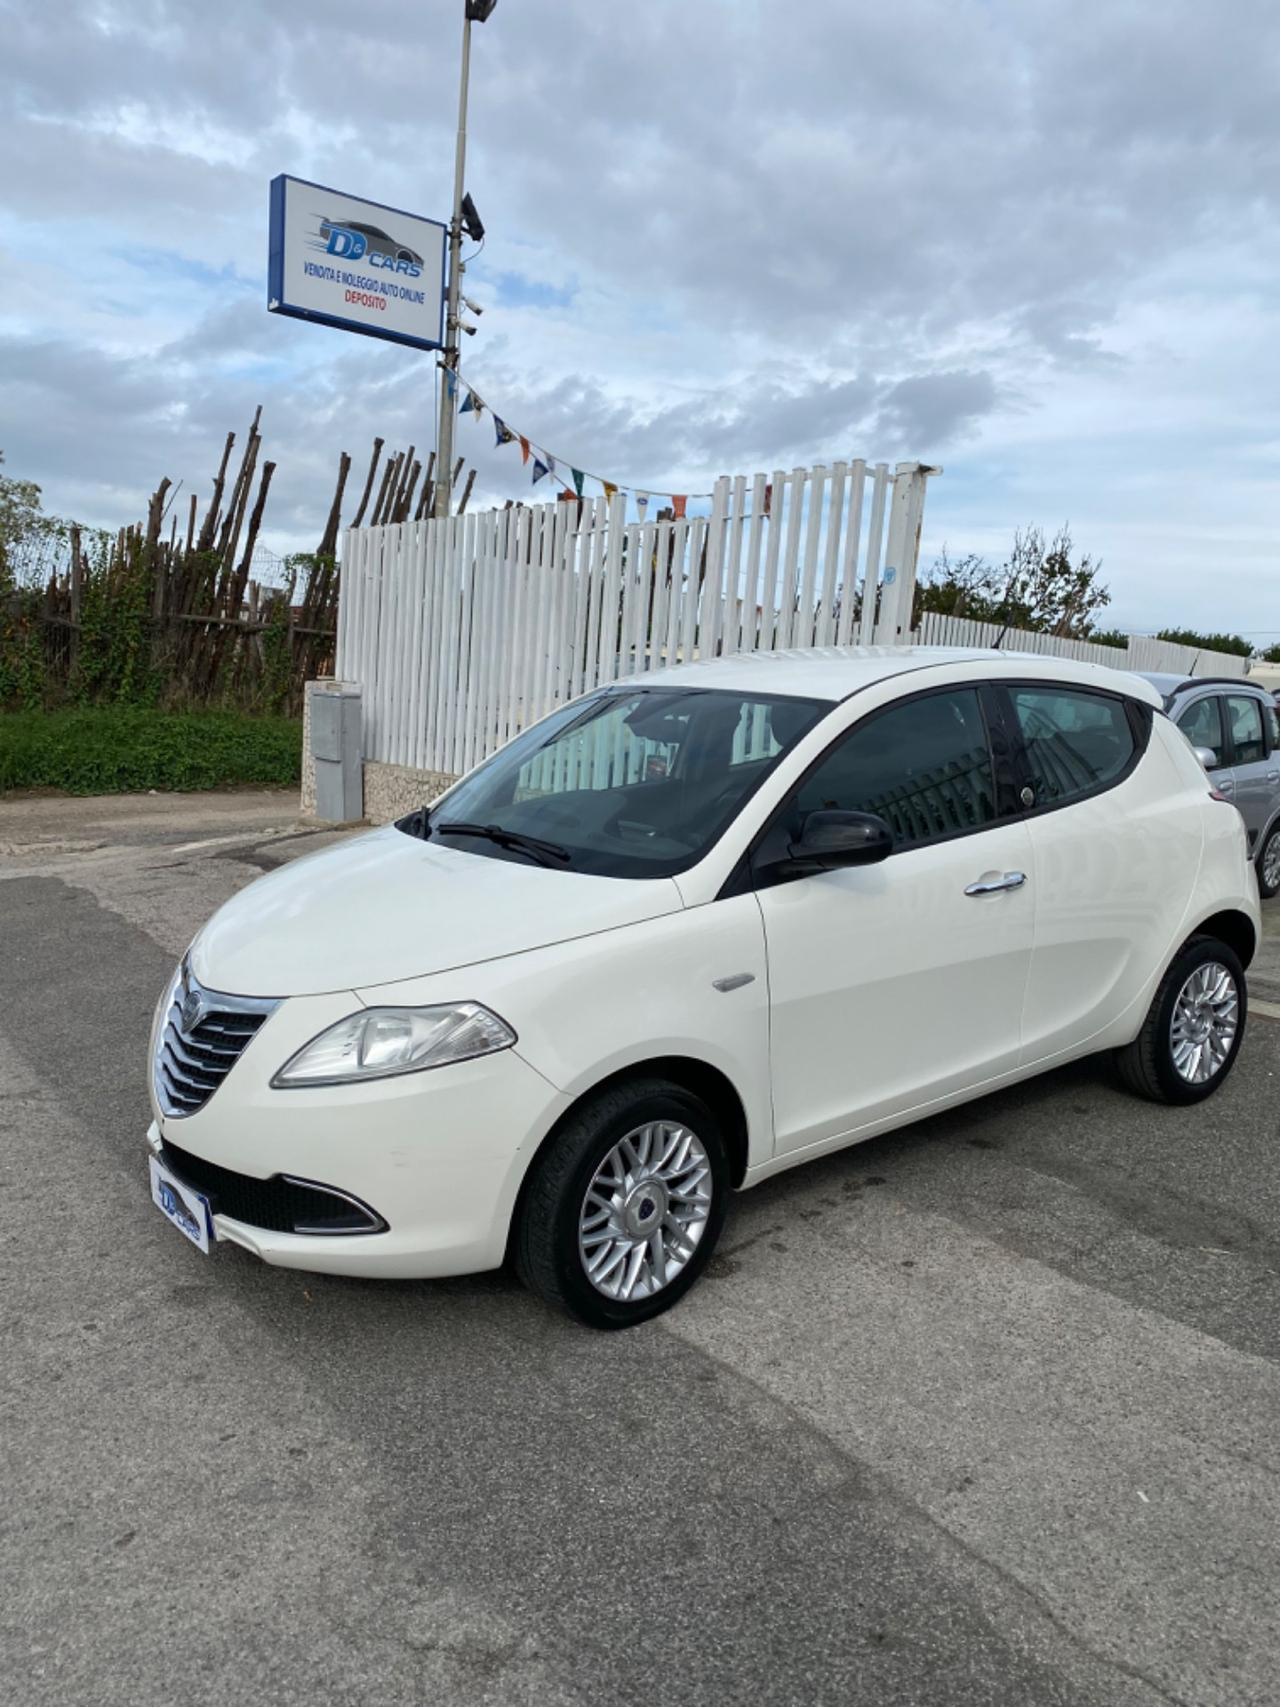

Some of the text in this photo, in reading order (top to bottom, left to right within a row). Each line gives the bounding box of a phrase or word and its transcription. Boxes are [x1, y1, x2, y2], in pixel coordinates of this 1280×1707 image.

[369, 251, 421, 277] CARS
[304, 261, 335, 280] VENDITA
[336, 270, 341, 283] E
[379, 282, 398, 298] AUTO
[399, 287, 425, 304] ONLINE
[345, 289, 386, 311] DEPOSITO
